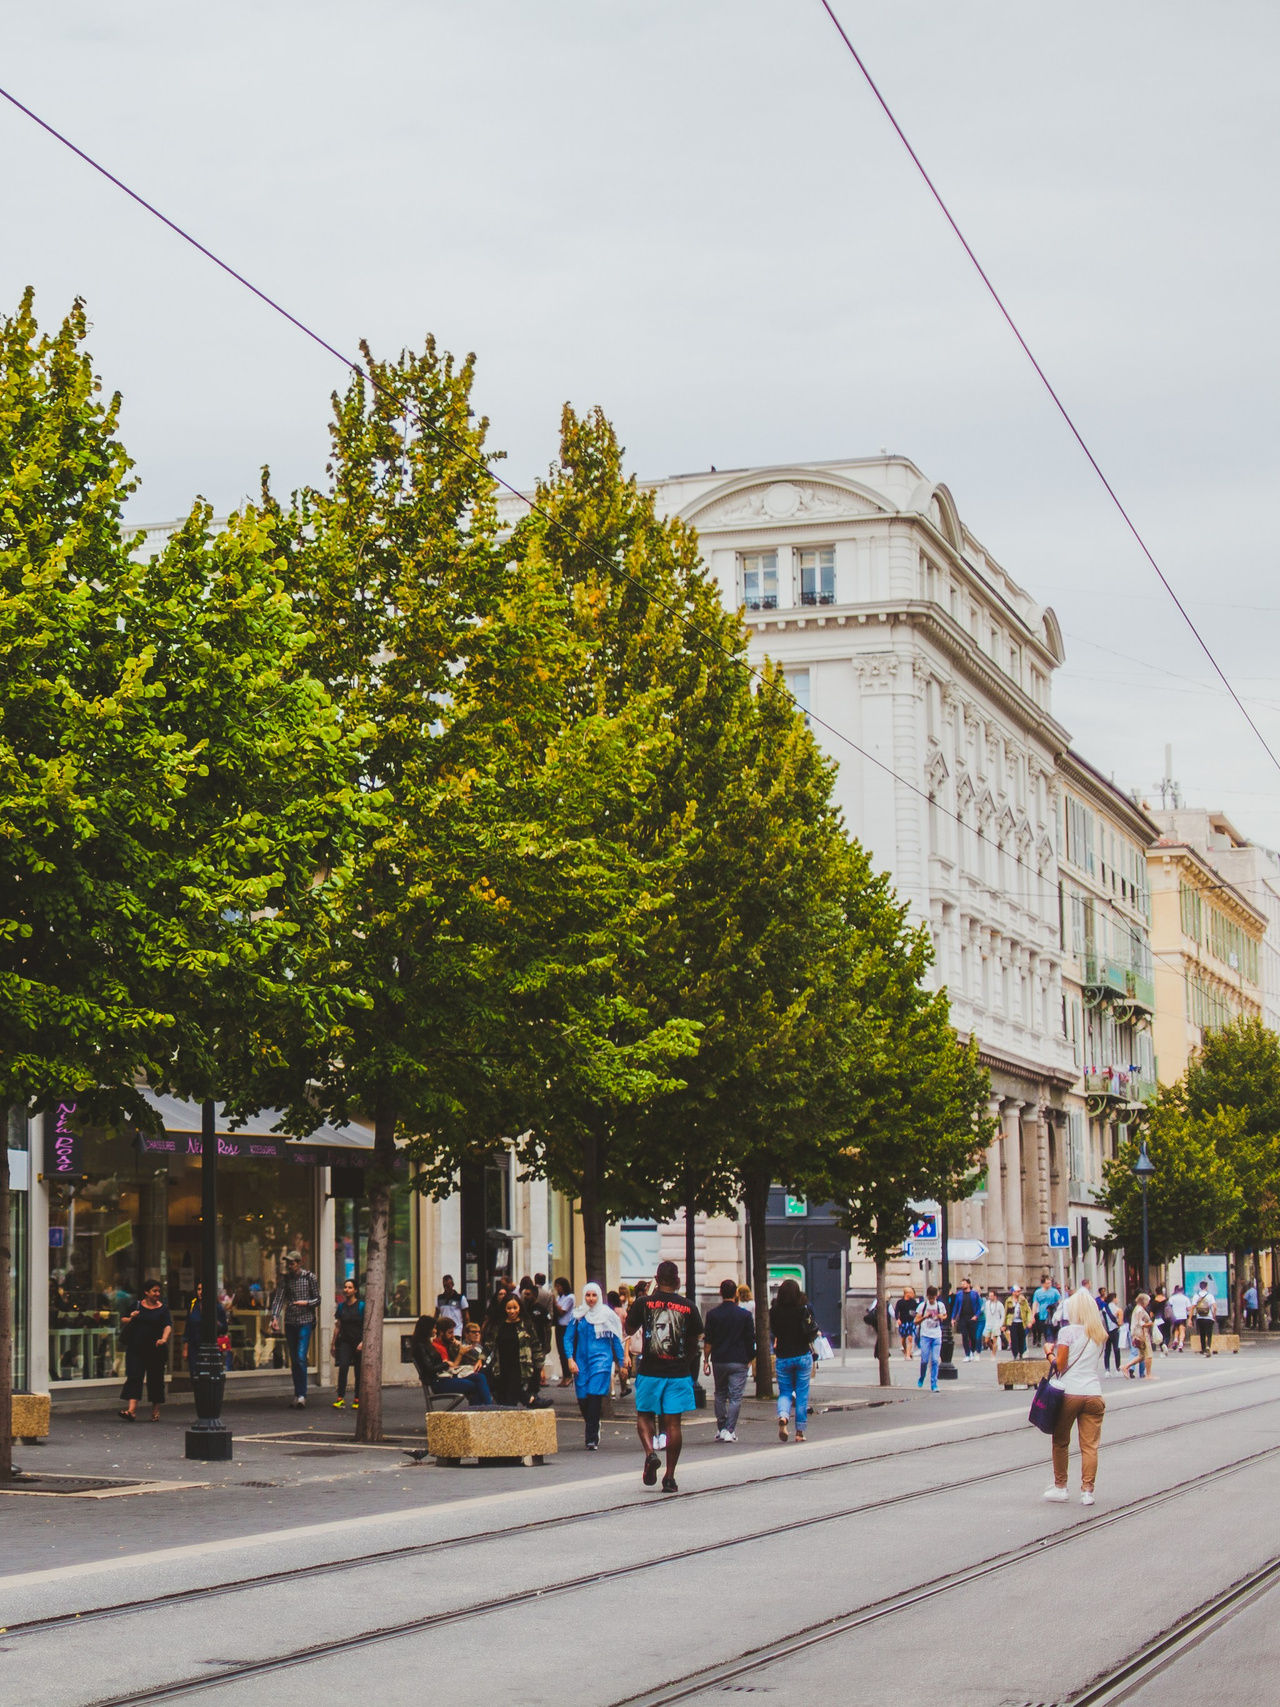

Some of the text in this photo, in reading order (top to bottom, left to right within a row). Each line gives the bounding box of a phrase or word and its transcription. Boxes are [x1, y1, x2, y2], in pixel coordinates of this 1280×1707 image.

[55, 1137, 74, 1171] Rose
[146, 1140, 176, 1151] CHAUSSURES
[217, 1138, 240, 1155] Rose
